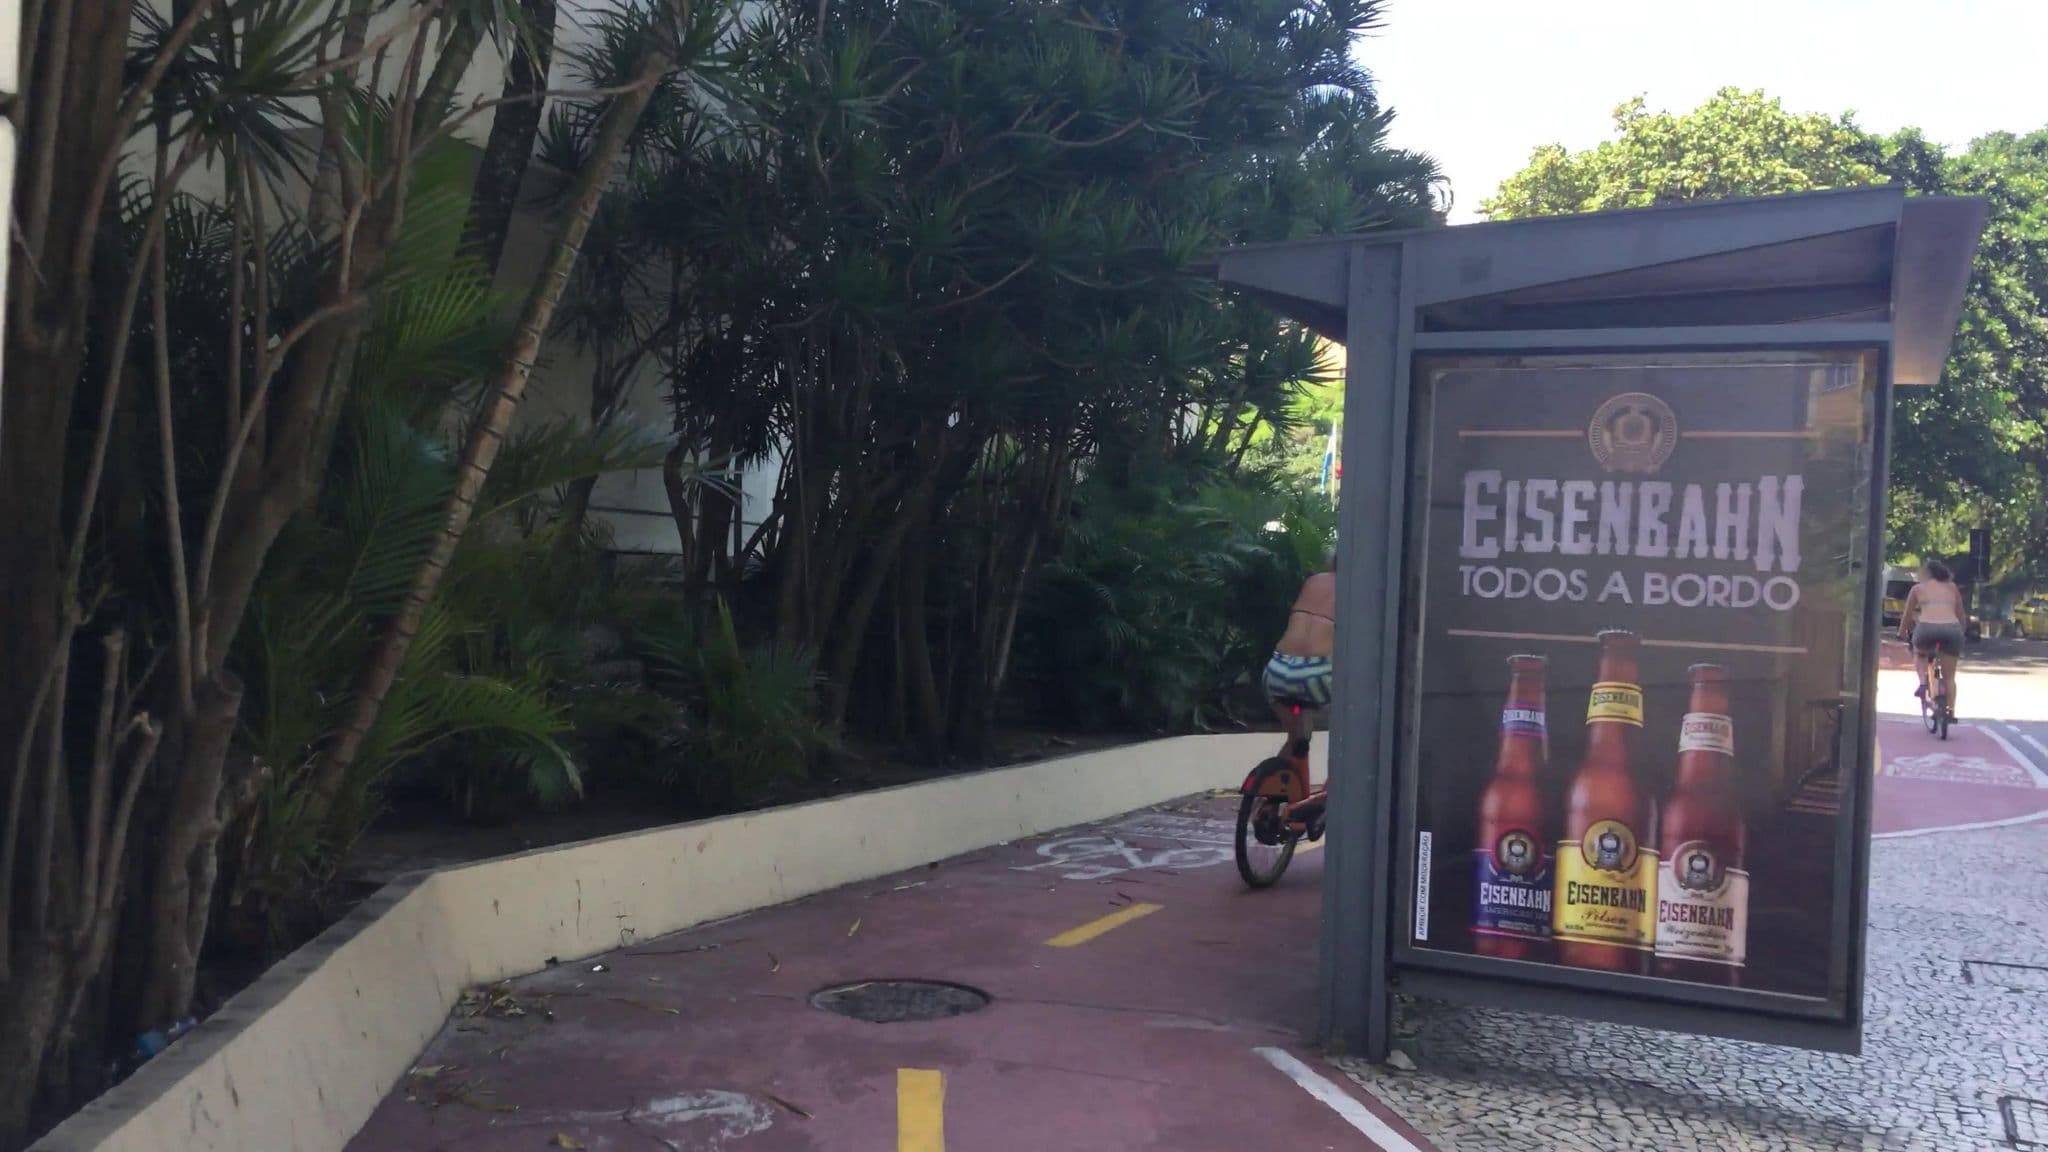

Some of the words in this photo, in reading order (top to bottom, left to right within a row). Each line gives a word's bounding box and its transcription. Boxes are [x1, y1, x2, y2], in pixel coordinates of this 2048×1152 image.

[1459, 469, 1804, 572] EISENBAHN
[1459, 565, 1588, 601] TODOS
[1597, 571, 1633, 605] A
[1643, 571, 1801, 611] BORDO
[1480, 881, 1552, 913] EISENBAHN
[1567, 880, 1647, 914] EISENBAHN
[1581, 907, 1628, 925] Pilsen
[1659, 899, 1735, 931] EISENBAHN
